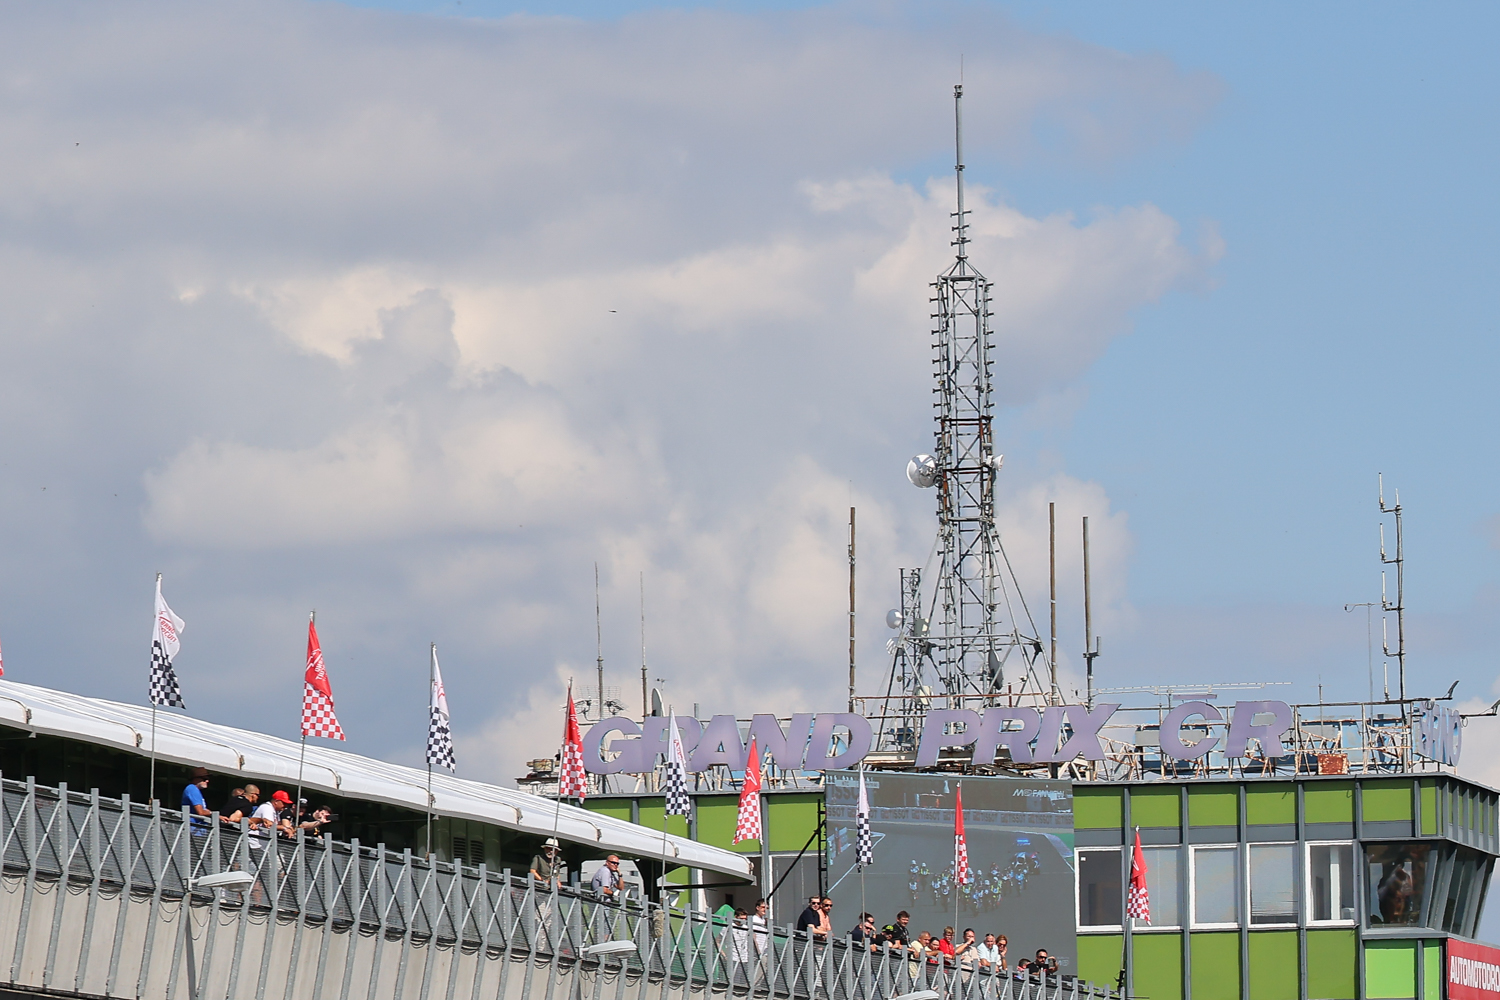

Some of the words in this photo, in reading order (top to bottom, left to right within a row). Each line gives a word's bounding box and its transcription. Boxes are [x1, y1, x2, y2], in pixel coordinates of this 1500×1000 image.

[583, 713, 873, 774] GRAND
[915, 703, 1122, 767] PRIX
[1159, 694, 1294, 760] ČR
